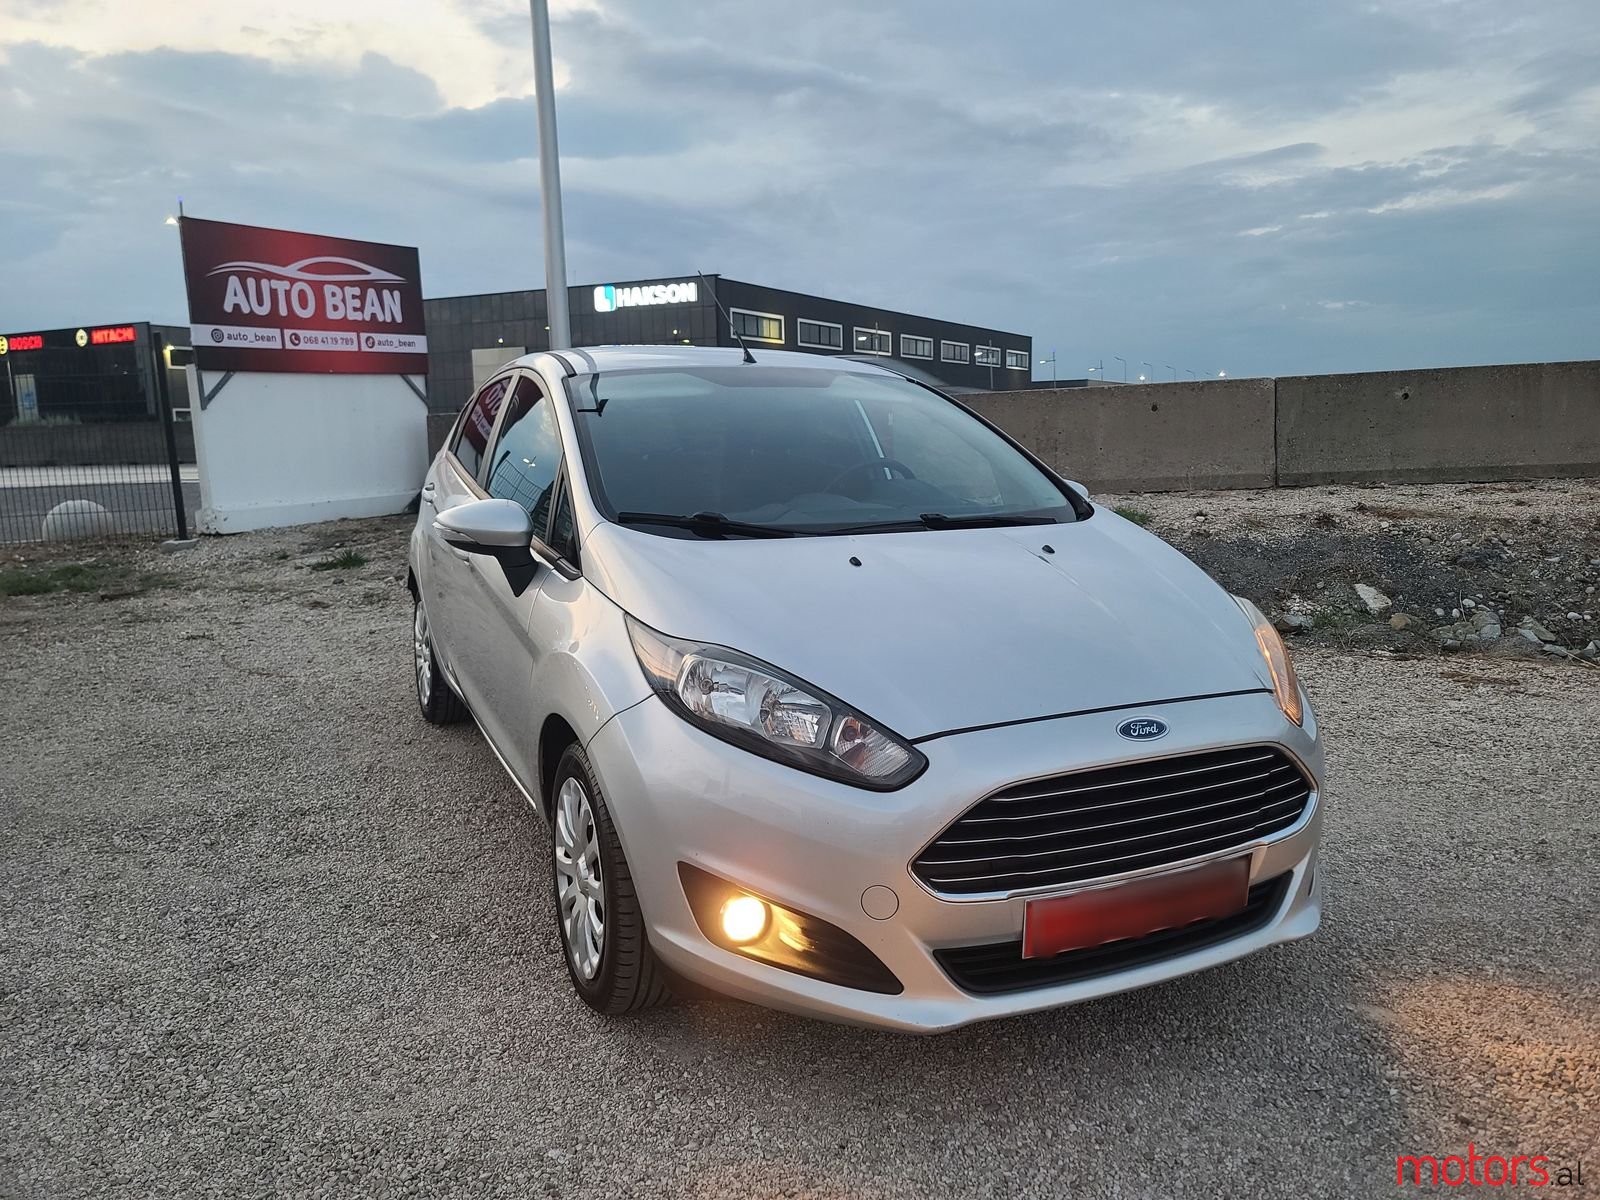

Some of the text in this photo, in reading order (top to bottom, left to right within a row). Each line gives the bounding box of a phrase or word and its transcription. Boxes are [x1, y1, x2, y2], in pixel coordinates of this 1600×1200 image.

[223, 275, 403, 323] AUTO BEAN
[616, 282, 697, 307] HAKSON
[91, 326, 134, 344] HITACHI
[227, 332, 277, 343] auto_bean
[303, 336, 319, 345] 068
[377, 339, 416, 348] auto_bean
[1130, 721, 1159, 736] Ford
